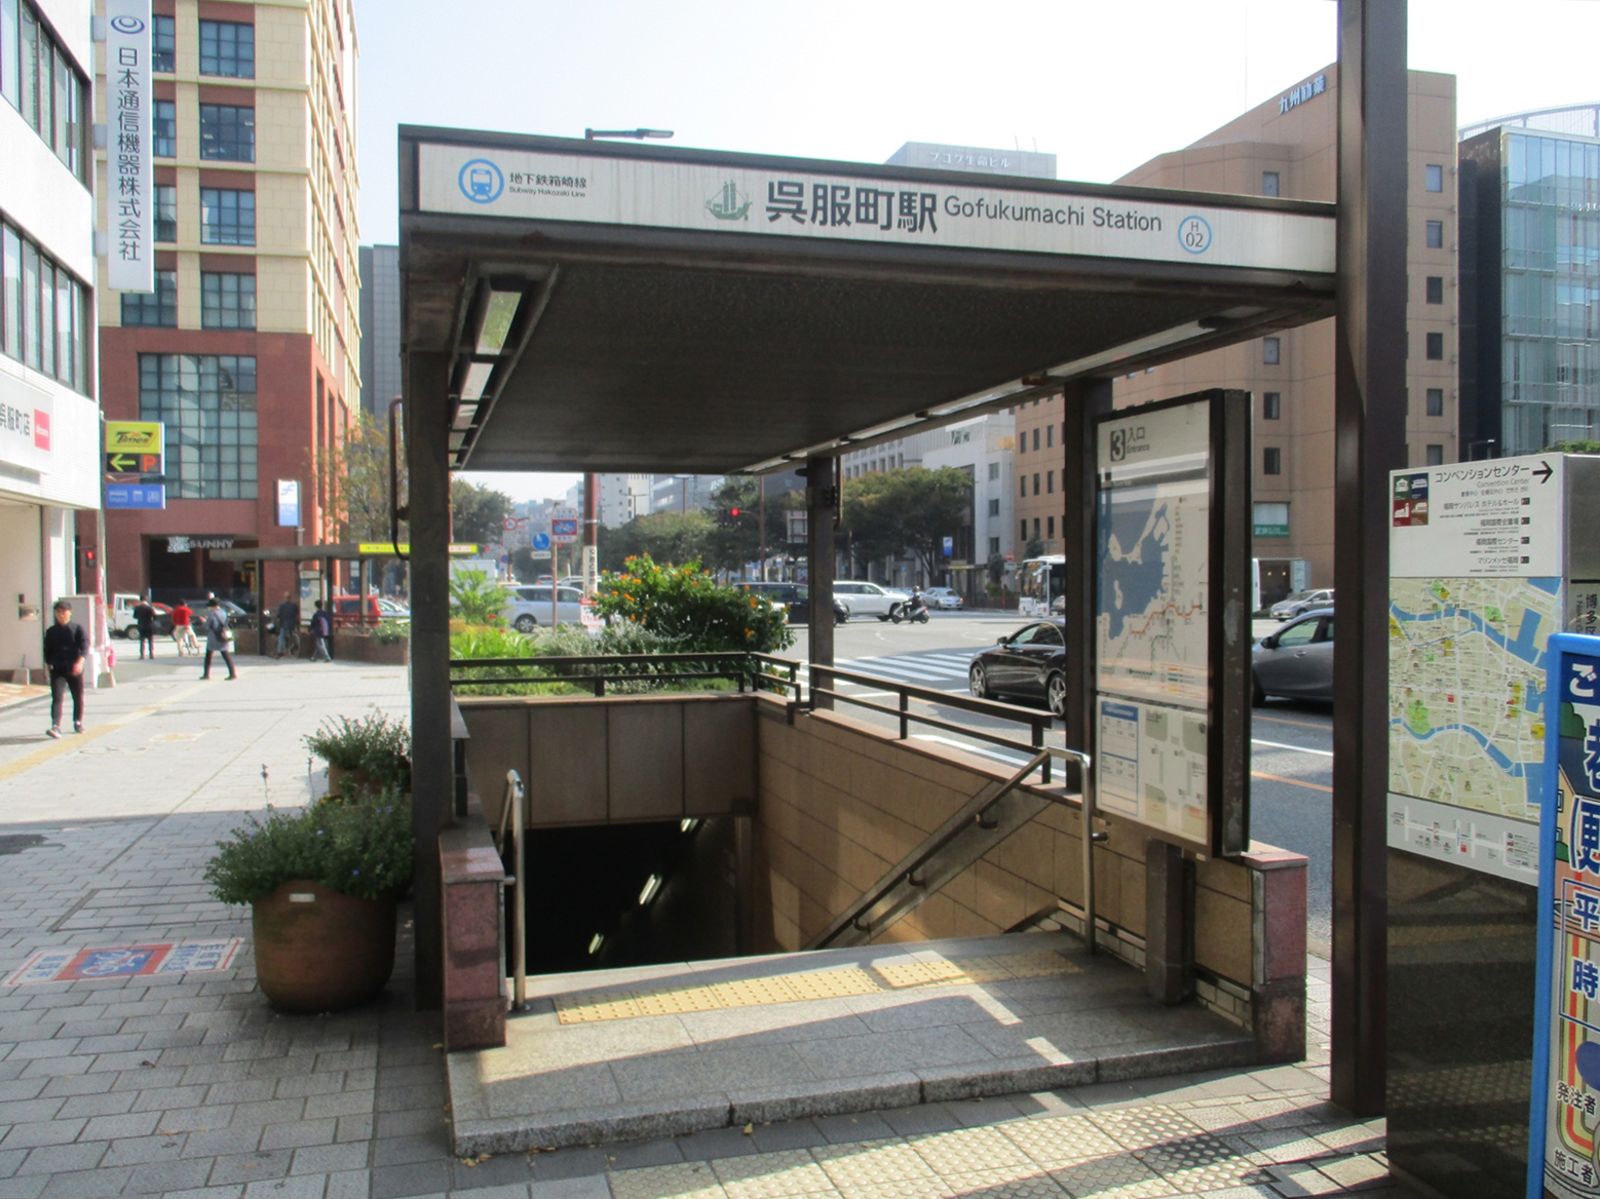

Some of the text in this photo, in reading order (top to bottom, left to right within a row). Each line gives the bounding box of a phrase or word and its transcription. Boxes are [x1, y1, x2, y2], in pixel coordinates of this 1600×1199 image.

[118, 47, 141, 261] 日本通信機器株式会社
[509, 186, 537, 196] Subway
[765, 180, 938, 235] 呉服町駅
[944, 195, 1162, 232] Gofukumachi Station
[1185, 232, 1204, 248] 02
[1190, 221, 1199, 232] H
[1112, 430, 1124, 460] 3
[1127, 426, 1146, 443] 入口
[143, 454, 157, 472] P
[1435, 465, 1530, 483] コンベンションセンター
[1569, 663, 1597, 698] ご
[1572, 958, 1600, 999] 時
[1557, 1082, 1597, 1116] 発注者
[1553, 1150, 1595, 1186] 施工者
